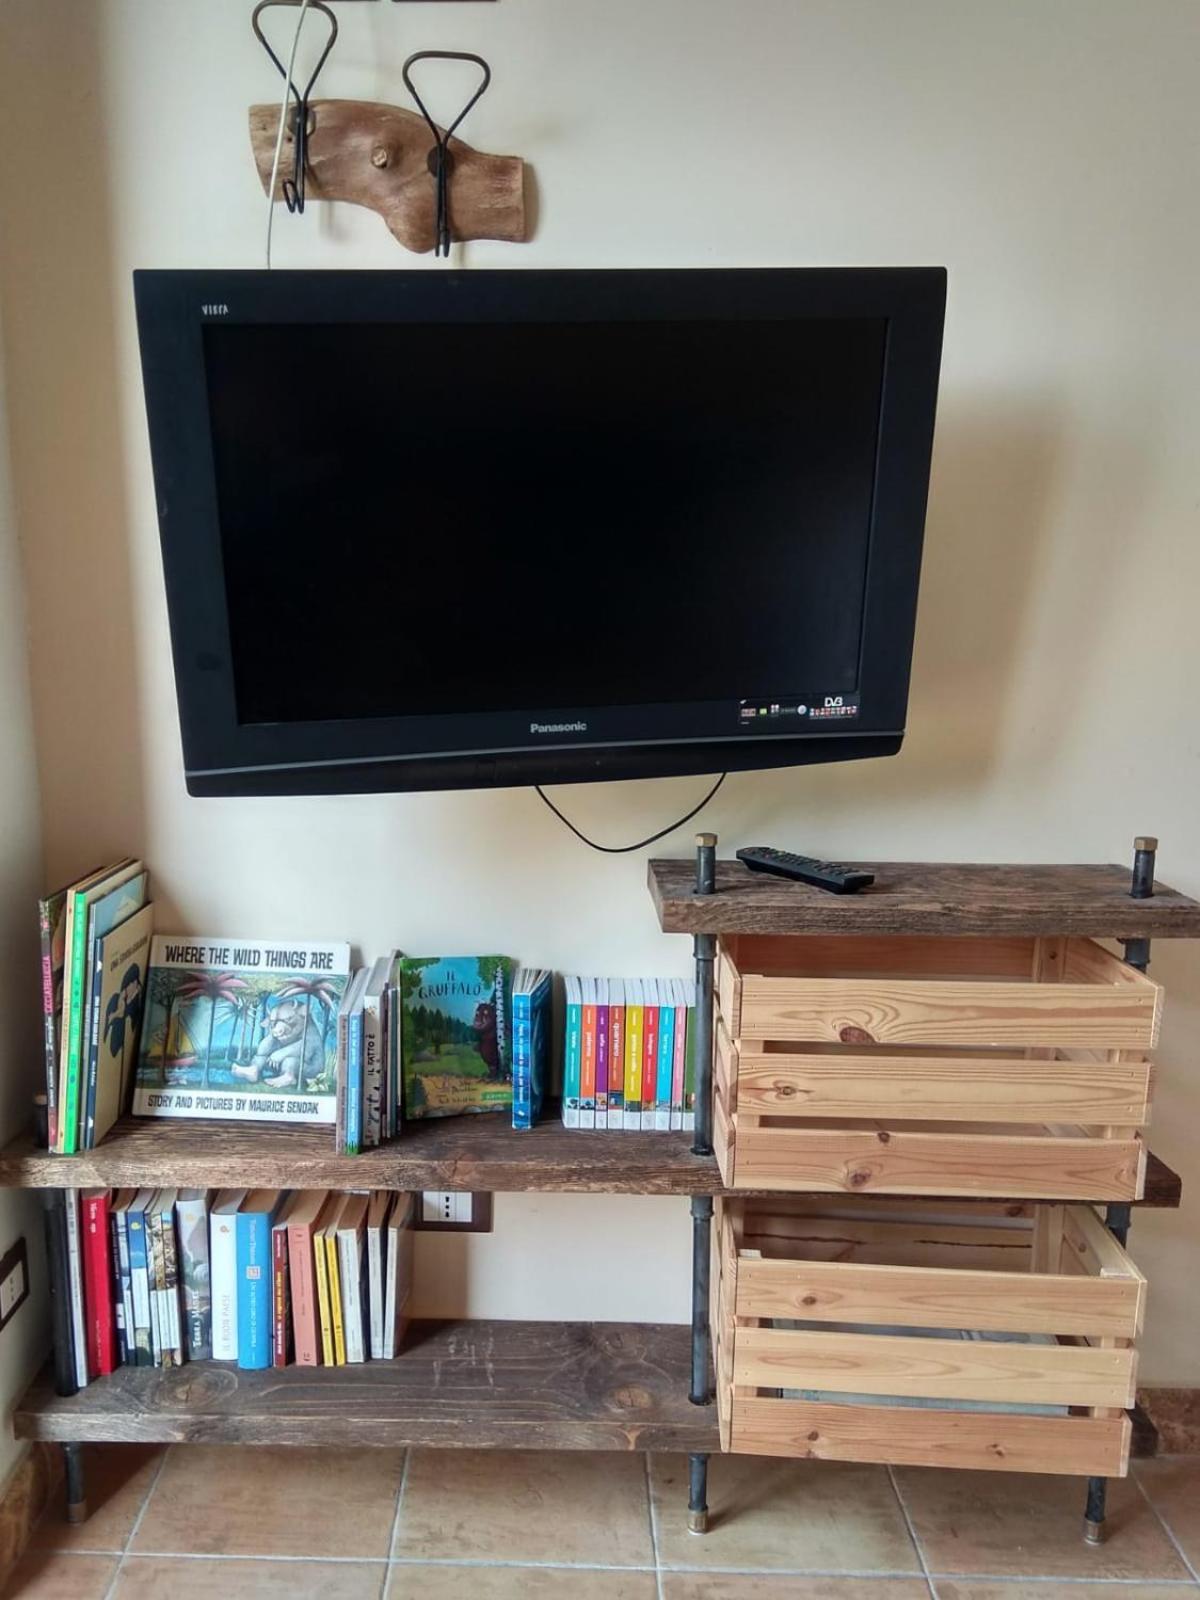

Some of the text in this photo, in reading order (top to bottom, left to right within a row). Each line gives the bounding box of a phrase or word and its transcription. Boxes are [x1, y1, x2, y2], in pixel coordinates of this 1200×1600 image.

[530, 722, 587, 734] Panasonic
[165, 945, 205, 965] WHERE
[208, 946, 229, 965] THE
[232, 948, 261, 967] WILD
[264, 949, 307, 969] THINGS
[309, 952, 334, 969] ARE
[367, 1041, 376, 1065] FATTO
[148, 1095, 319, 1115] STORY AND PICTURES BY MAURICE SENDAK
